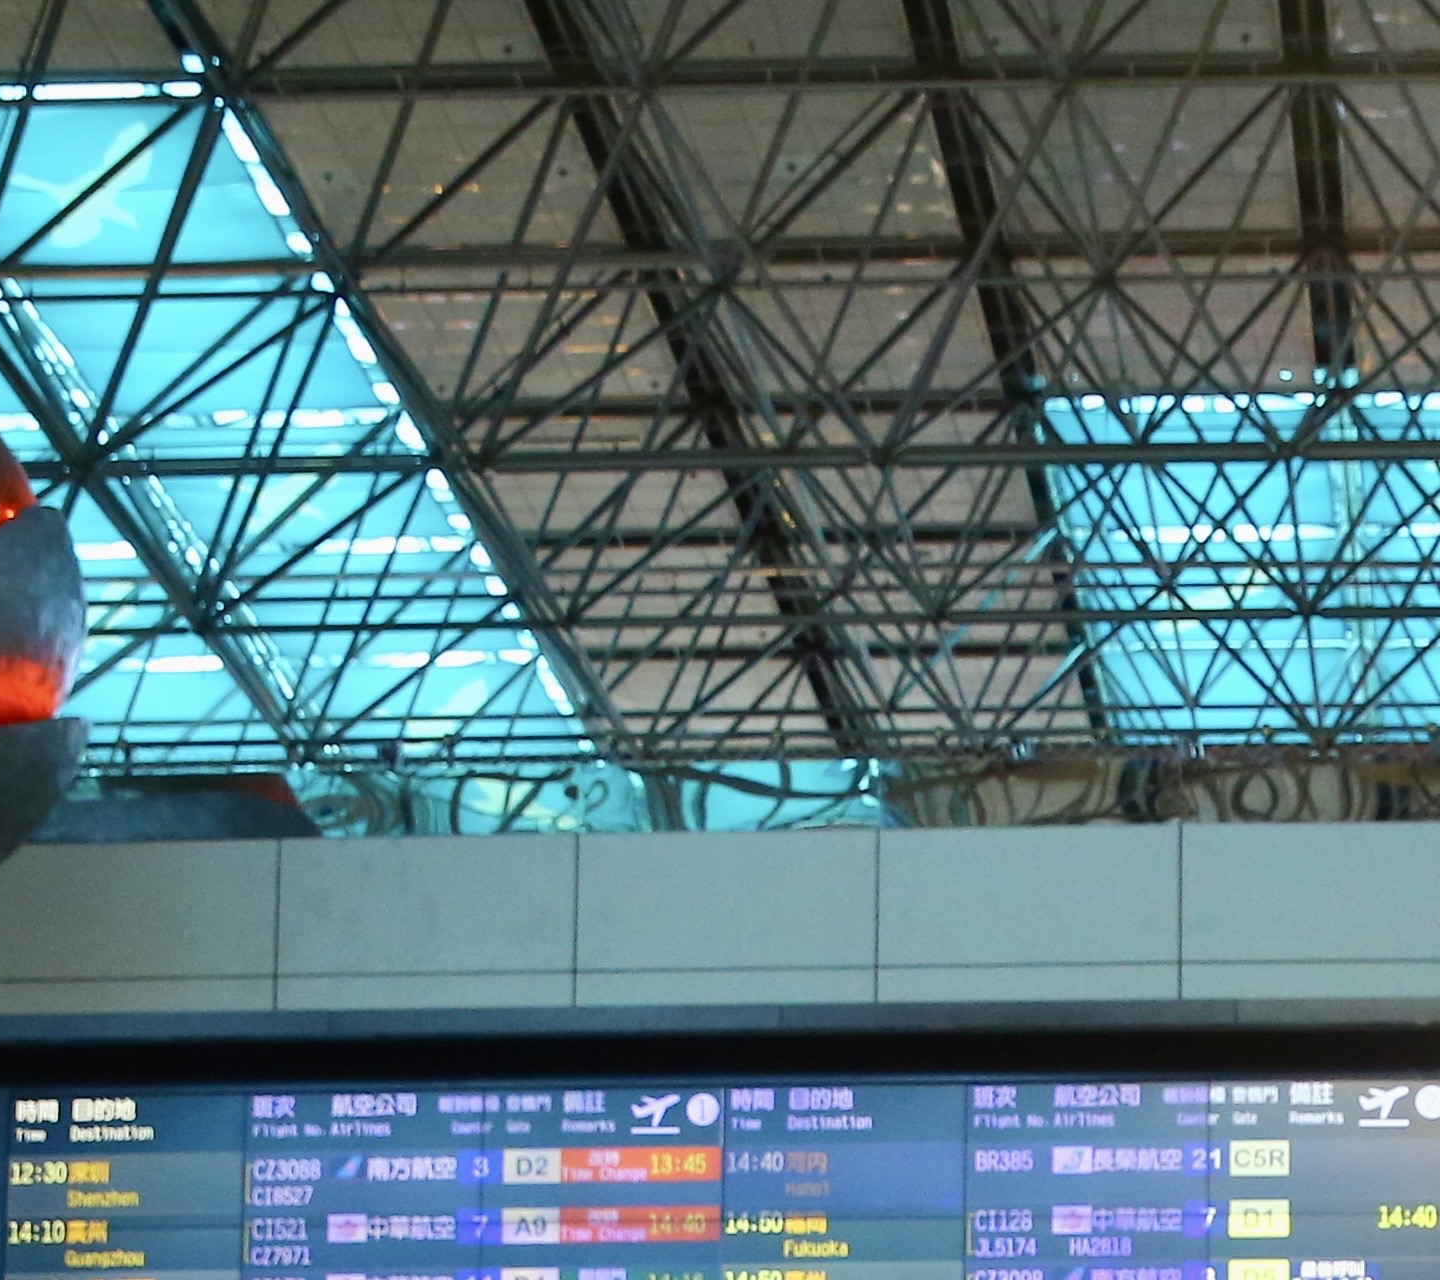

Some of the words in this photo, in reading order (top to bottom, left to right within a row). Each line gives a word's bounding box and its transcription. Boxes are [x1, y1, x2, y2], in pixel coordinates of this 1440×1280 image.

[472, 1157, 490, 1179] 3
[515, 1156, 549, 1178] D2
[650, 1152, 707, 1176] 13:45
[727, 1151, 785, 1174] 14:40
[1191, 1149, 1222, 1171] 21
[1232, 1149, 1287, 1167] C5R
[10, 1160, 68, 1185] 12:30
[366, 1215, 458, 1242] 中華航空
[472, 1215, 490, 1239] 7
[515, 1216, 548, 1237] A9
[1377, 1204, 1440, 1230] 14:40
[9, 1219, 67, 1245] 14:10
[783, 1239, 850, 1258] Fukuoka
